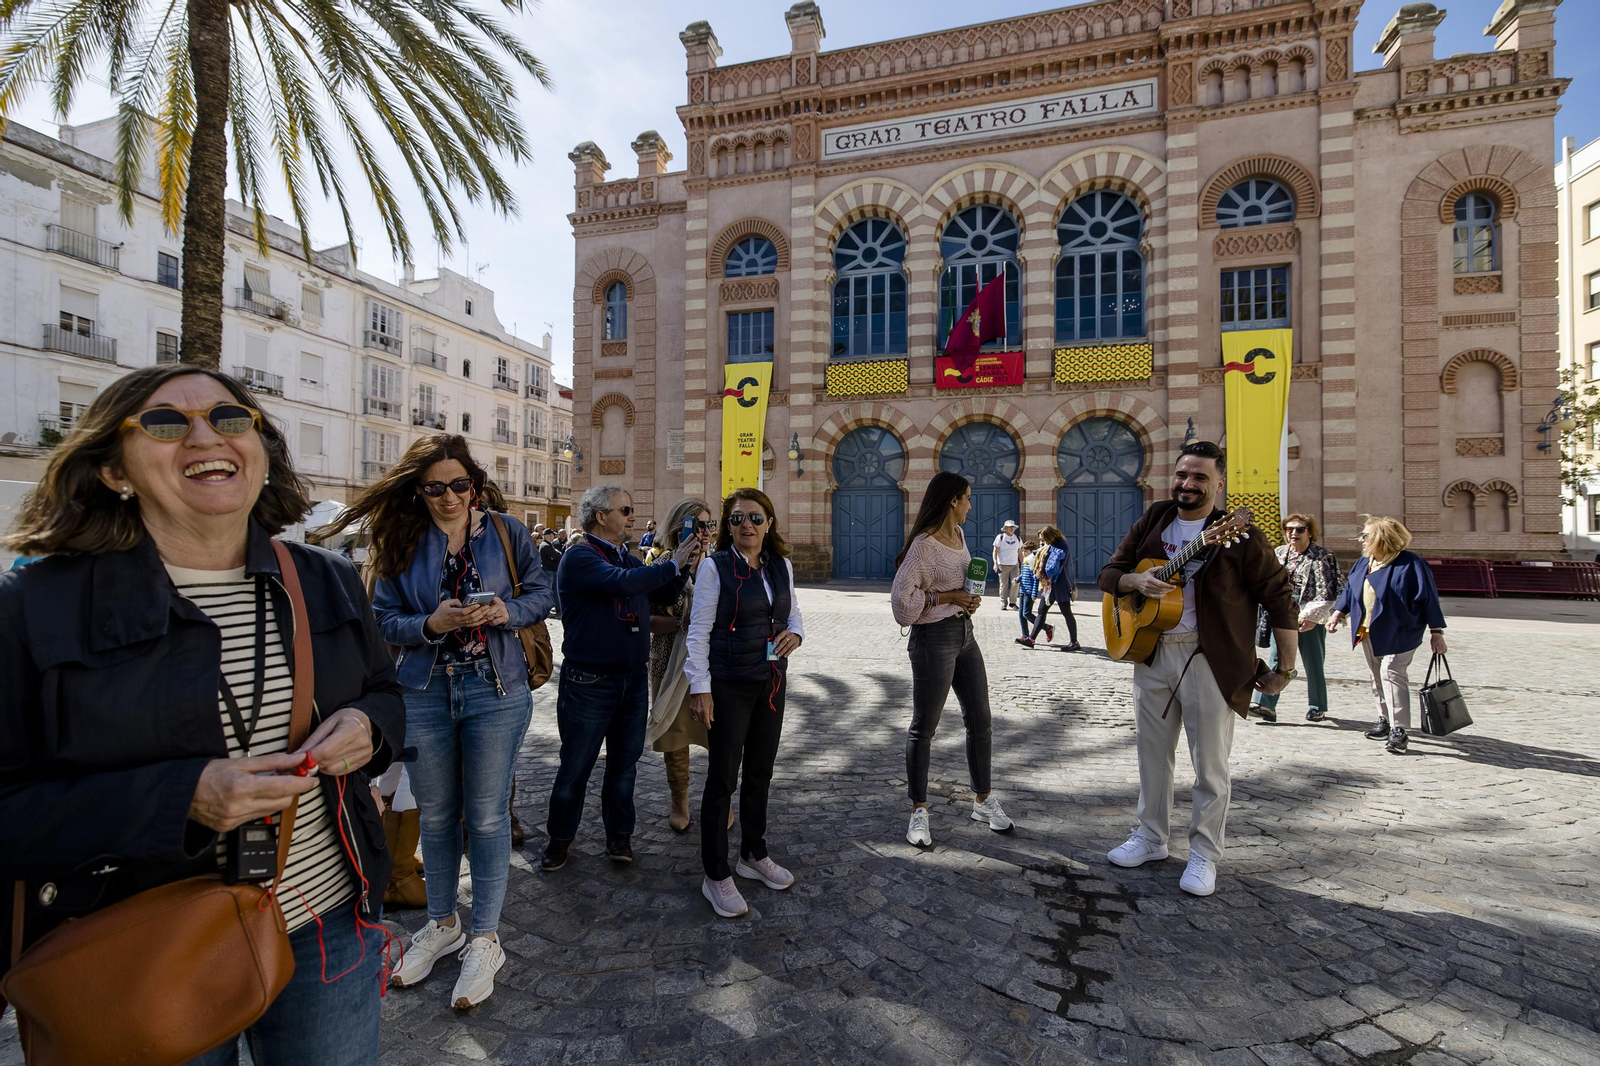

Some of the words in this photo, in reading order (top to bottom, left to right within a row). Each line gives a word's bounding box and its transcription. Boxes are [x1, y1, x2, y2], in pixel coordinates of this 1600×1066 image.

[834, 126, 901, 150] GRAN
[915, 108, 1027, 139] TEATRO
[1040, 90, 1140, 120] FALLA
